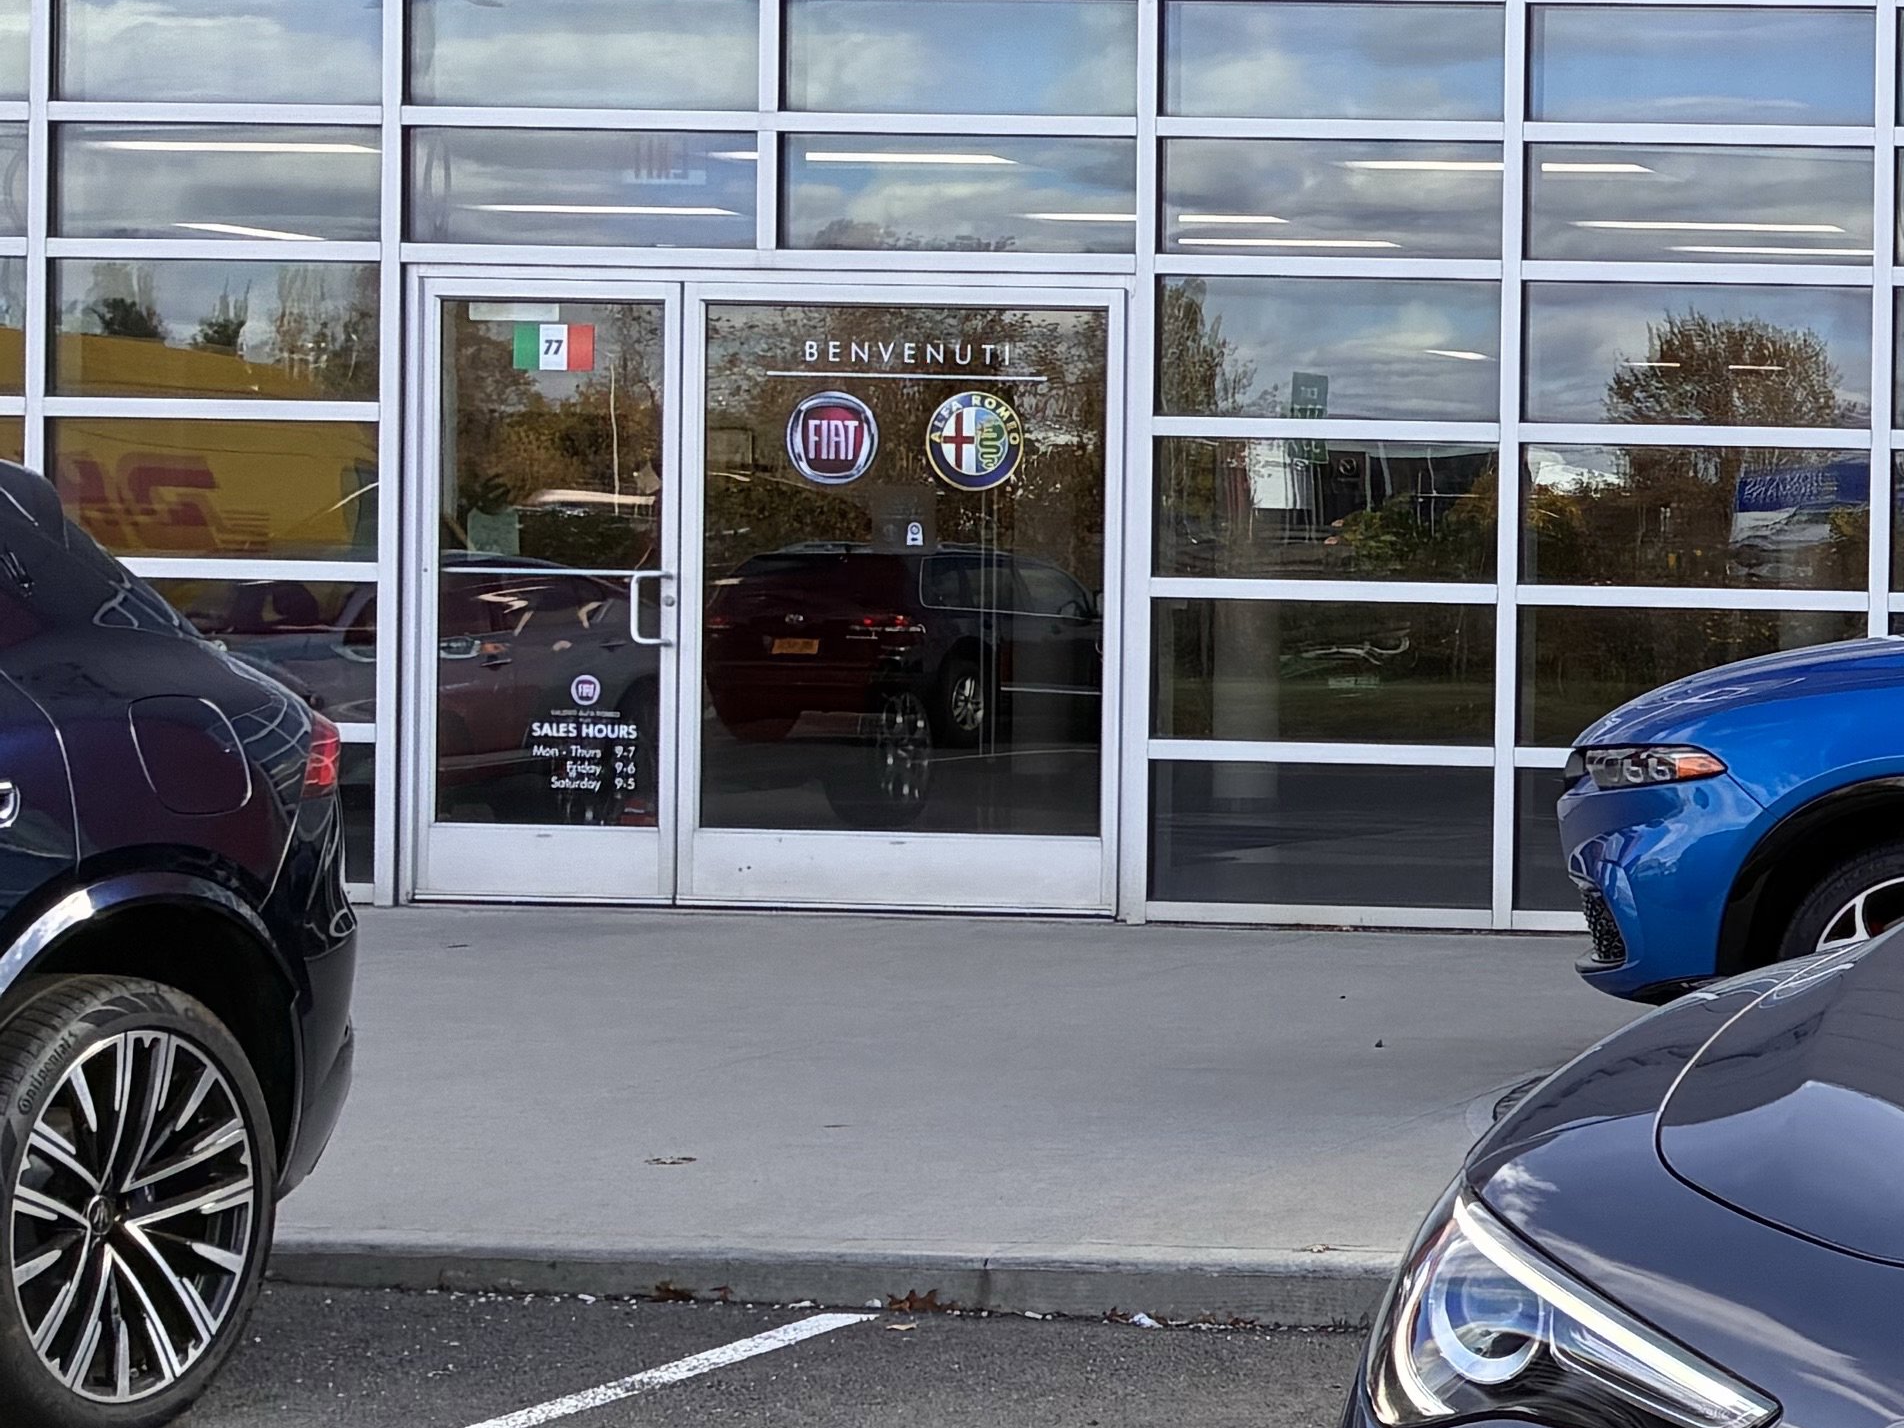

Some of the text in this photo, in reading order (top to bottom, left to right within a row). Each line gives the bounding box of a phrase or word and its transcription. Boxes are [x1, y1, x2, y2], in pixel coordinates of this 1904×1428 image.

[543, 339, 564, 356] 77
[804, 340, 1010, 367] BENVENUTI
[929, 393, 1021, 446] ALFA ROMEO
[807, 418, 860, 461] FIAT
[531, 722, 638, 739] SALES HOURS
[532, 744, 559, 757] Mon
[570, 745, 602, 758] Thurs
[566, 760, 602, 776] Friday
[550, 775, 602, 792] Saturday
